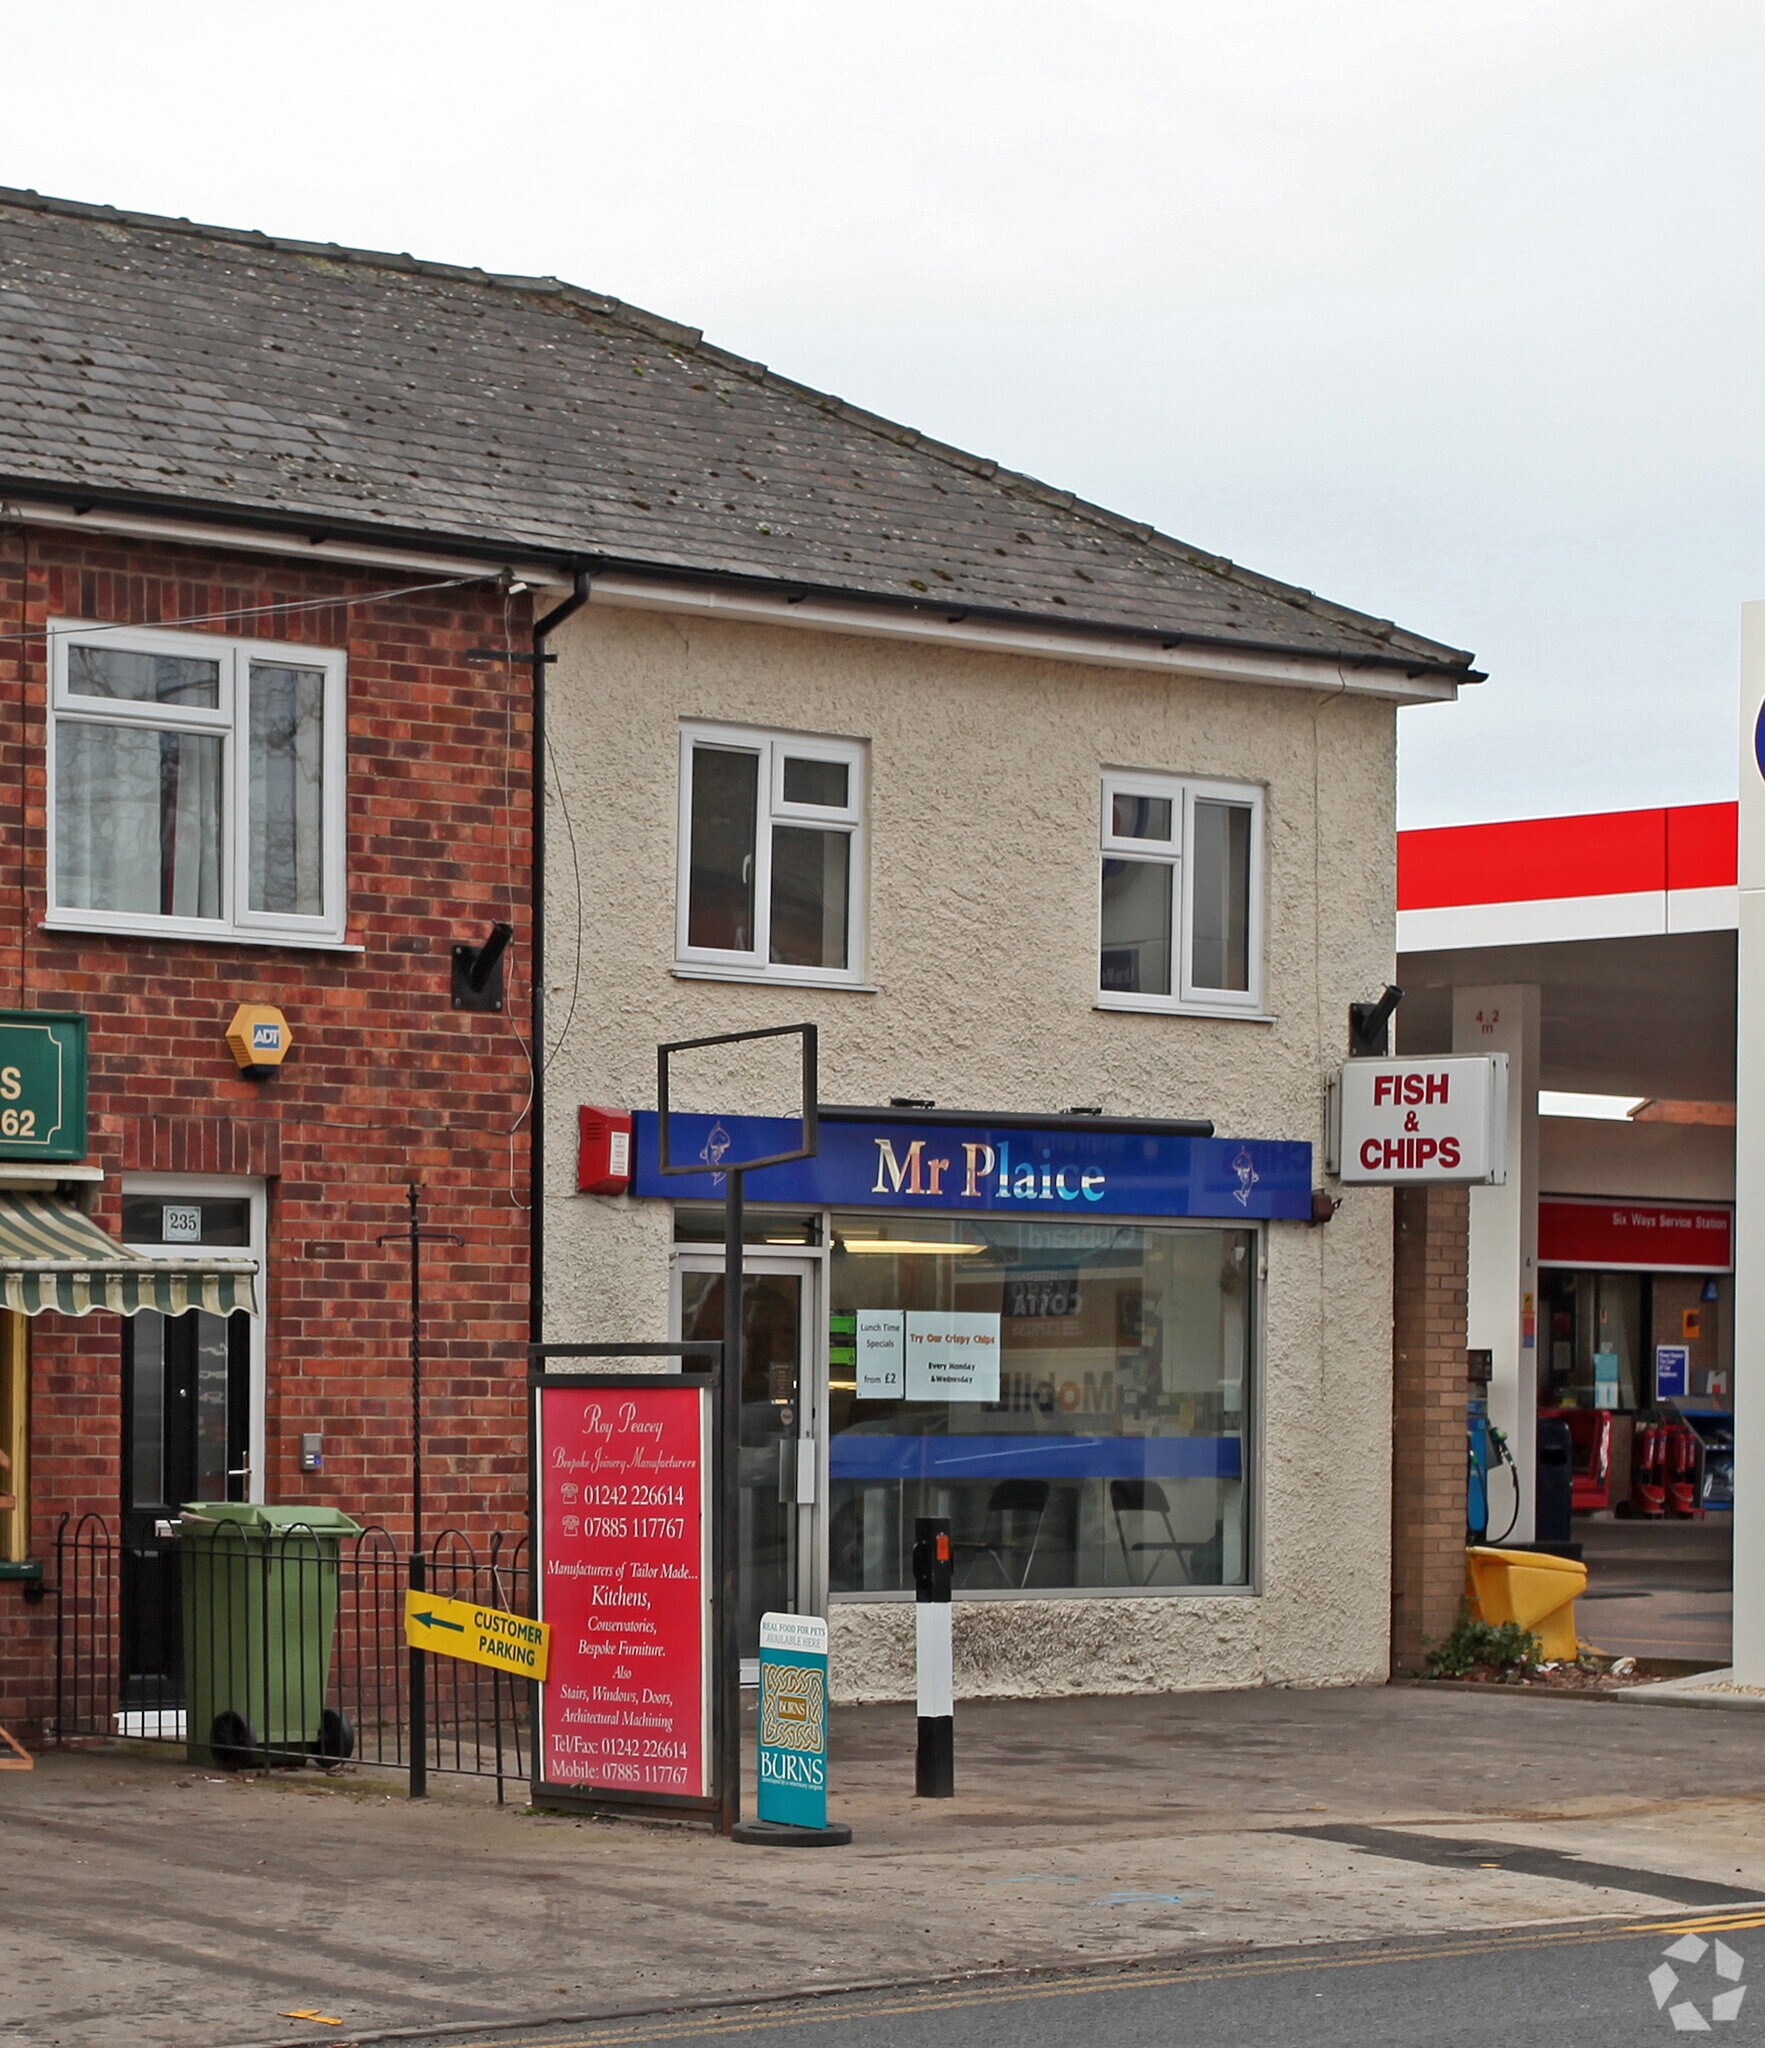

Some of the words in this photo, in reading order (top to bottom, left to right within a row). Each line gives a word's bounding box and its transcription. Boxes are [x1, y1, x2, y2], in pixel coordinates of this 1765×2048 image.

[254, 1029, 280, 1045] ADT
[1482, 1024, 1494, 1034] m
[1374, 1073, 1449, 1106] FISH
[1, 1109, 36, 1137] 62
[1404, 1110, 1420, 1132] &
[1360, 1136, 1461, 1170] CHIPS
[871, 1138, 950, 1195] Mr
[960, 1141, 1106, 1201] Plaice
[169, 1213, 197, 1231] 235
[1612, 1212, 1627, 1226] Six
[1631, 1213, 1656, 1228] Ways
[1659, 1214, 1692, 1228] Service
[1696, 1216, 1727, 1229] Station
[860, 1324, 882, 1332] Lunch
[883, 1324, 900, 1332] Time
[866, 1340, 894, 1348] Specials
[910, 1334, 923, 1344] Try
[926, 1334, 942, 1342] Our
[945, 1334, 970, 1345] Crispy
[973, 1334, 995, 1345] Chips
[928, 1362, 947, 1372] Every
[949, 1363, 976, 1371] Monday
[864, 1376, 881, 1384] from
[884, 1373, 896, 1384] £2
[582, 1403, 613, 1442] Roy
[618, 1402, 663, 1442] Peacey
[552, 1446, 590, 1474] Bespoke
[590, 1447, 626, 1474] Joinery
[627, 1447, 696, 1474] Manufacturers
[584, 1485, 627, 1505] 01242
[631, 1485, 685, 1506] 226614
[584, 1517, 627, 1538] 07885
[633, 1518, 685, 1539] 117767
[547, 1560, 613, 1580] Manufacturers
[615, 1562, 627, 1581] of
[630, 1562, 659, 1579] Tailor
[660, 1563, 698, 1579] Made...
[591, 1585, 651, 1610] Kitchens,
[474, 1611, 543, 1645] CUSTOMER
[587, 1616, 657, 1635] Conservatories,
[762, 1622, 778, 1632] REAL
[779, 1622, 796, 1633] FOOD
[797, 1625, 809, 1635] FOR
[810, 1626, 826, 1637] PETS
[479, 1635, 535, 1666] PARKING
[578, 1639, 617, 1659] Bespoke
[618, 1641, 666, 1657] Furniture.
[765, 1633, 802, 1646] AVAILABLE
[802, 1637, 821, 1649] HERE
[612, 1665, 632, 1679] Also
[560, 1684, 590, 1702] Stairs,
[592, 1686, 639, 1705] Windows,
[642, 1688, 673, 1707] Doors,
[778, 1700, 806, 1717] BURNS
[561, 1707, 619, 1725] Architectural
[621, 1711, 673, 1733] Machining
[551, 1734, 599, 1755] Tel/Fax:
[601, 1738, 639, 1757] 01242
[642, 1740, 688, 1760] 226614
[552, 1760, 599, 1779] Mobile:
[602, 1763, 640, 1782] 07885
[644, 1765, 688, 1784] 117767
[761, 1751, 824, 1785] BURNS
